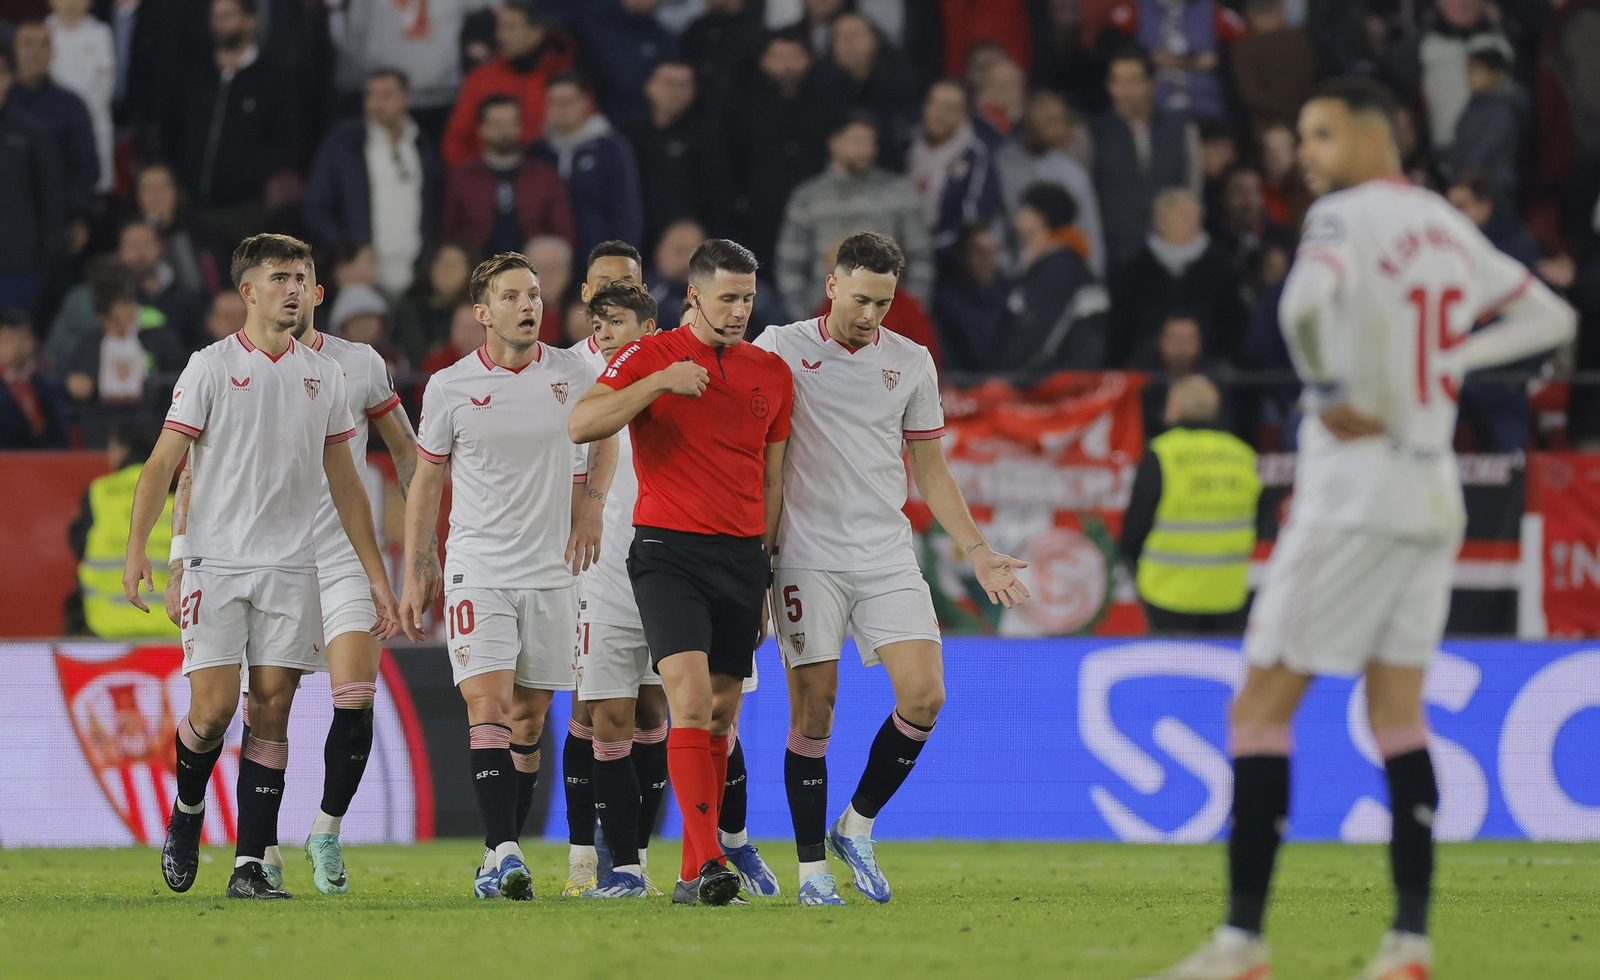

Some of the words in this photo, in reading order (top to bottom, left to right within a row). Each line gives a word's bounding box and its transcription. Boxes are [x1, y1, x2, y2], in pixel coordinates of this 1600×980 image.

[783, 584, 803, 622] 5
[448, 599, 475, 640] 10
[476, 769, 500, 780] SFC
[566, 776, 589, 785] SFC
[803, 778, 824, 787] SFC
[255, 786, 280, 796] SFC
